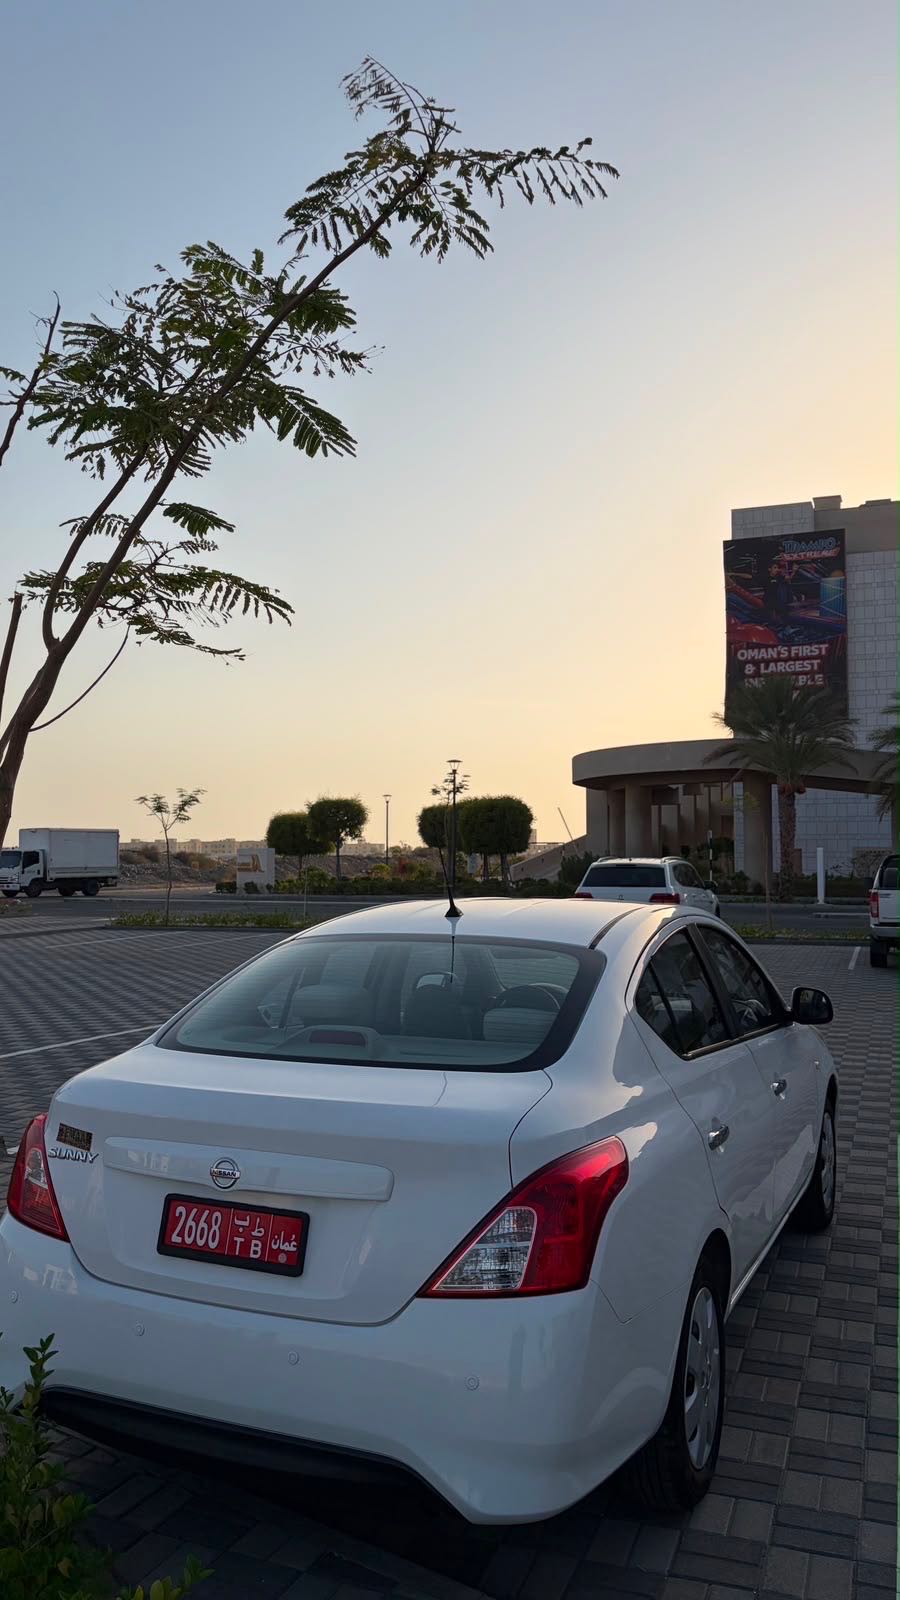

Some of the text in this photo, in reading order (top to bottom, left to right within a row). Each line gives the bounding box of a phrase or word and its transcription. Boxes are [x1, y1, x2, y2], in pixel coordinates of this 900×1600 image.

[737, 644, 829, 660] OMAN'S FIRST
[744, 660, 821, 675] & LARGEST
[47, 1147, 100, 1164] SUNNY
[212, 1169, 237, 1178] NISSAN
[171, 1206, 222, 1249] 2668
